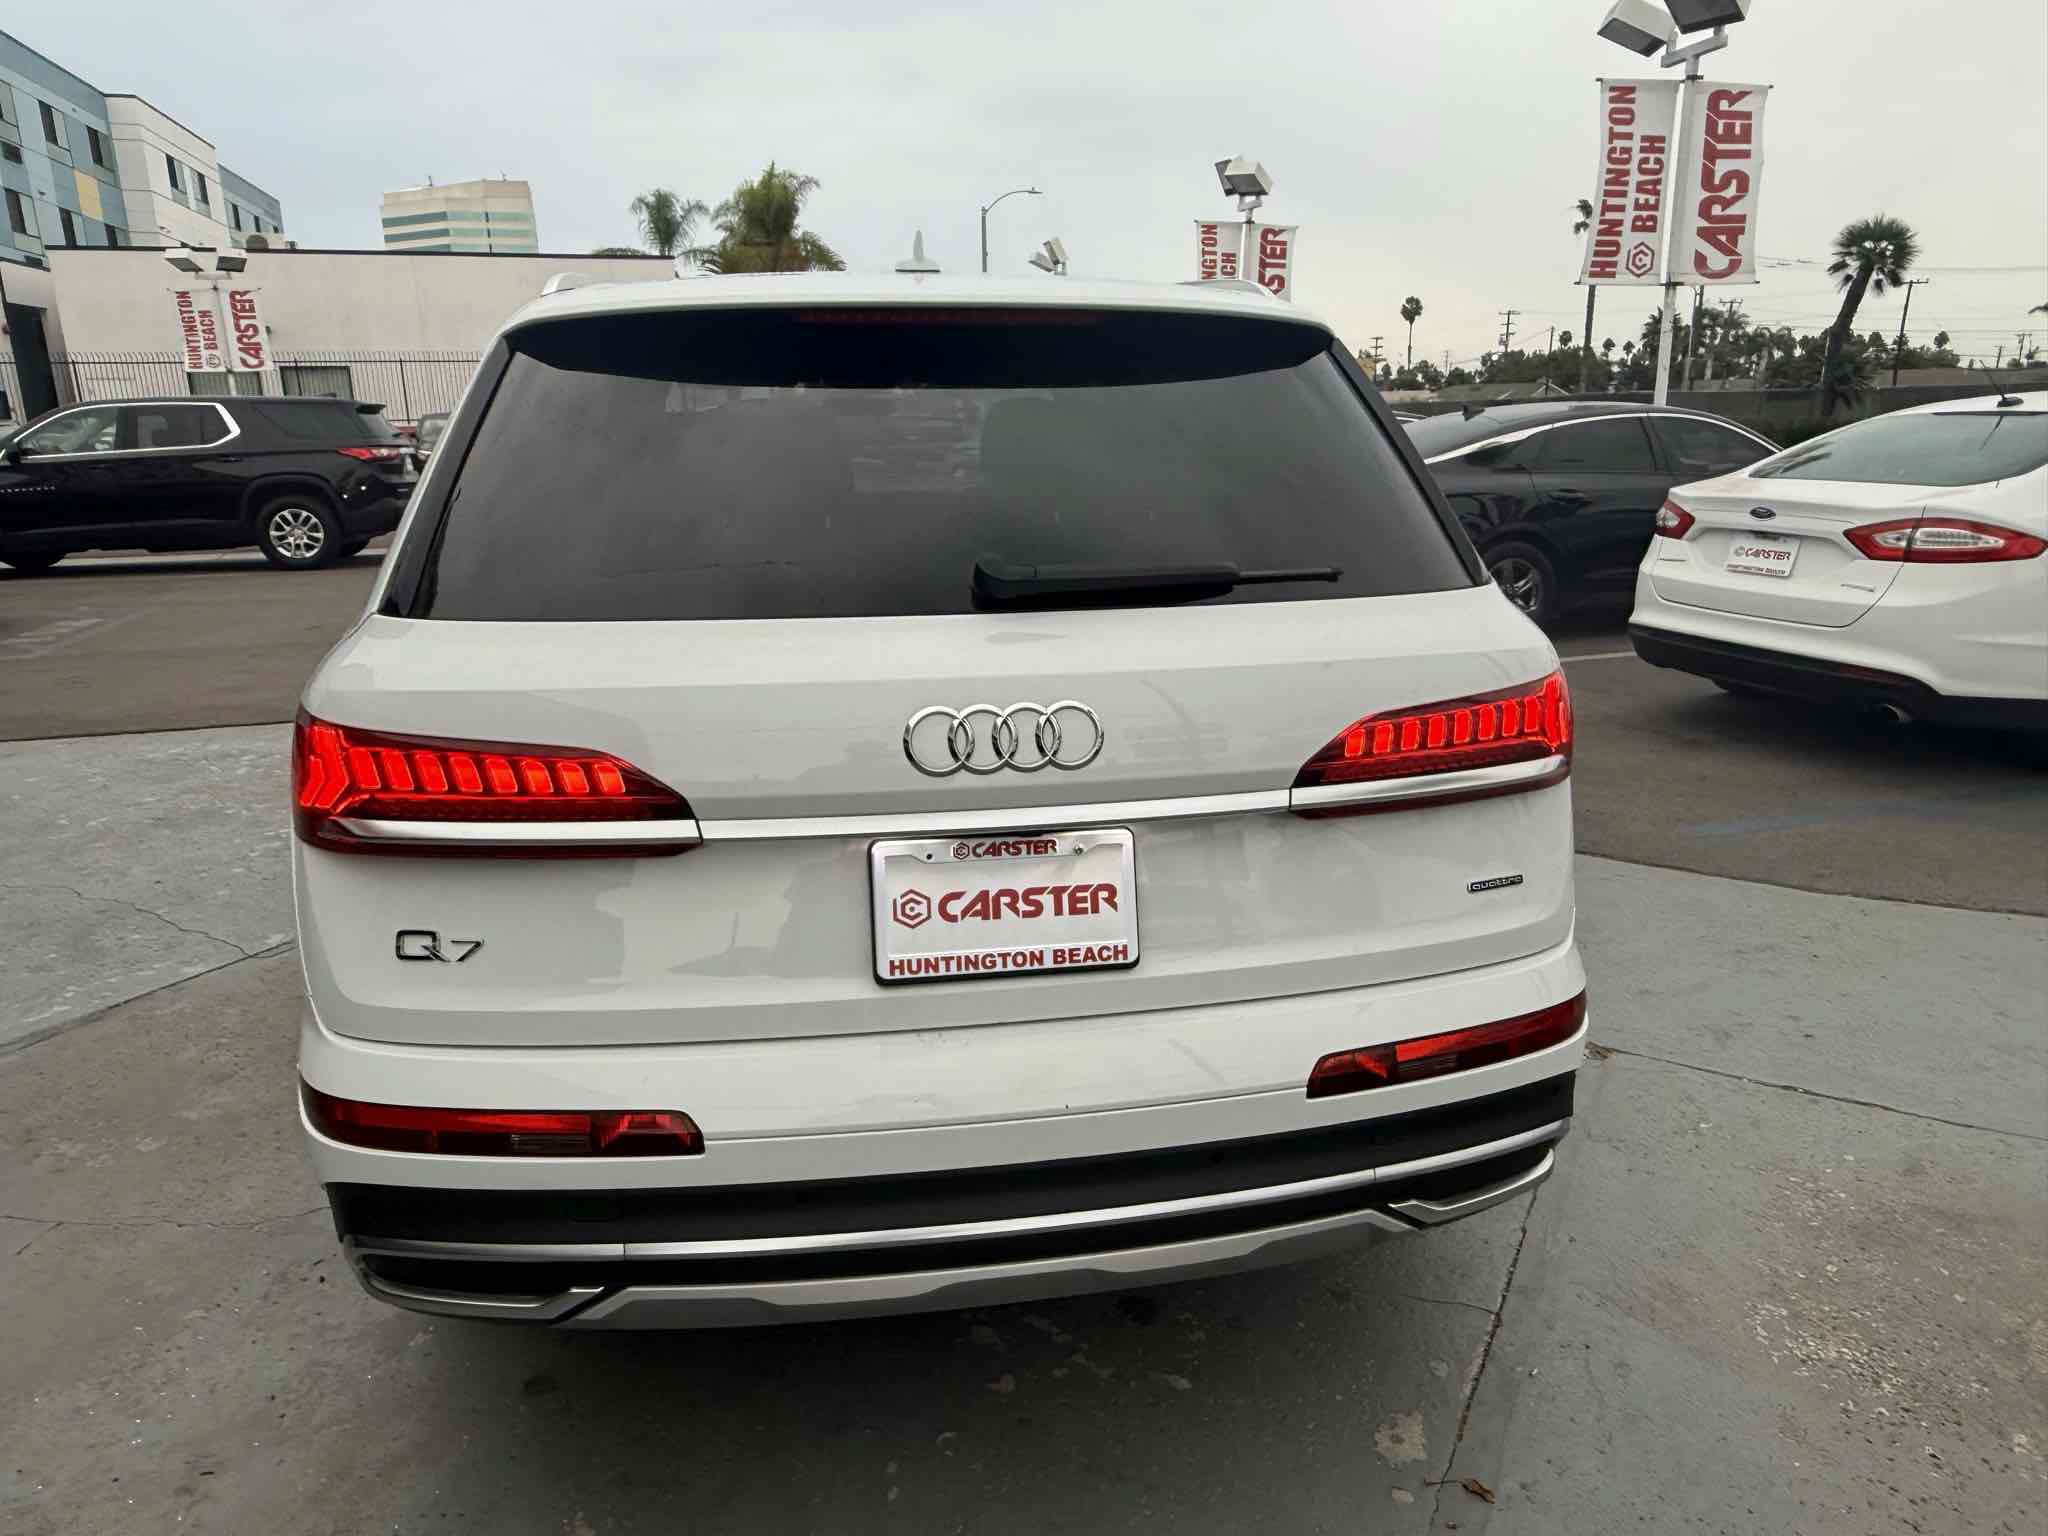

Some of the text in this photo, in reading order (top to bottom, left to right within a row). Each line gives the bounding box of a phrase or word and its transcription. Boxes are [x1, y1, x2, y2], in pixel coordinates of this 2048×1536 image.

[1589, 86, 1636, 278] HUNTINGTON
[1631, 135, 1666, 233] BEACH
[1694, 89, 1752, 279] CARSTER
[176, 291, 203, 369] HUNTINGTON
[198, 310, 218, 350] BEACH
[229, 290, 264, 369] CARSTER
[1744, 547, 1791, 561] CARSTER
[971, 839, 1057, 858] CARSTER
[937, 883, 1119, 923] CARSTER
[1470, 876, 1522, 891] quattro
[396, 930, 484, 962] Q7
[888, 944, 1129, 977] HUNTINGTON BEACH
